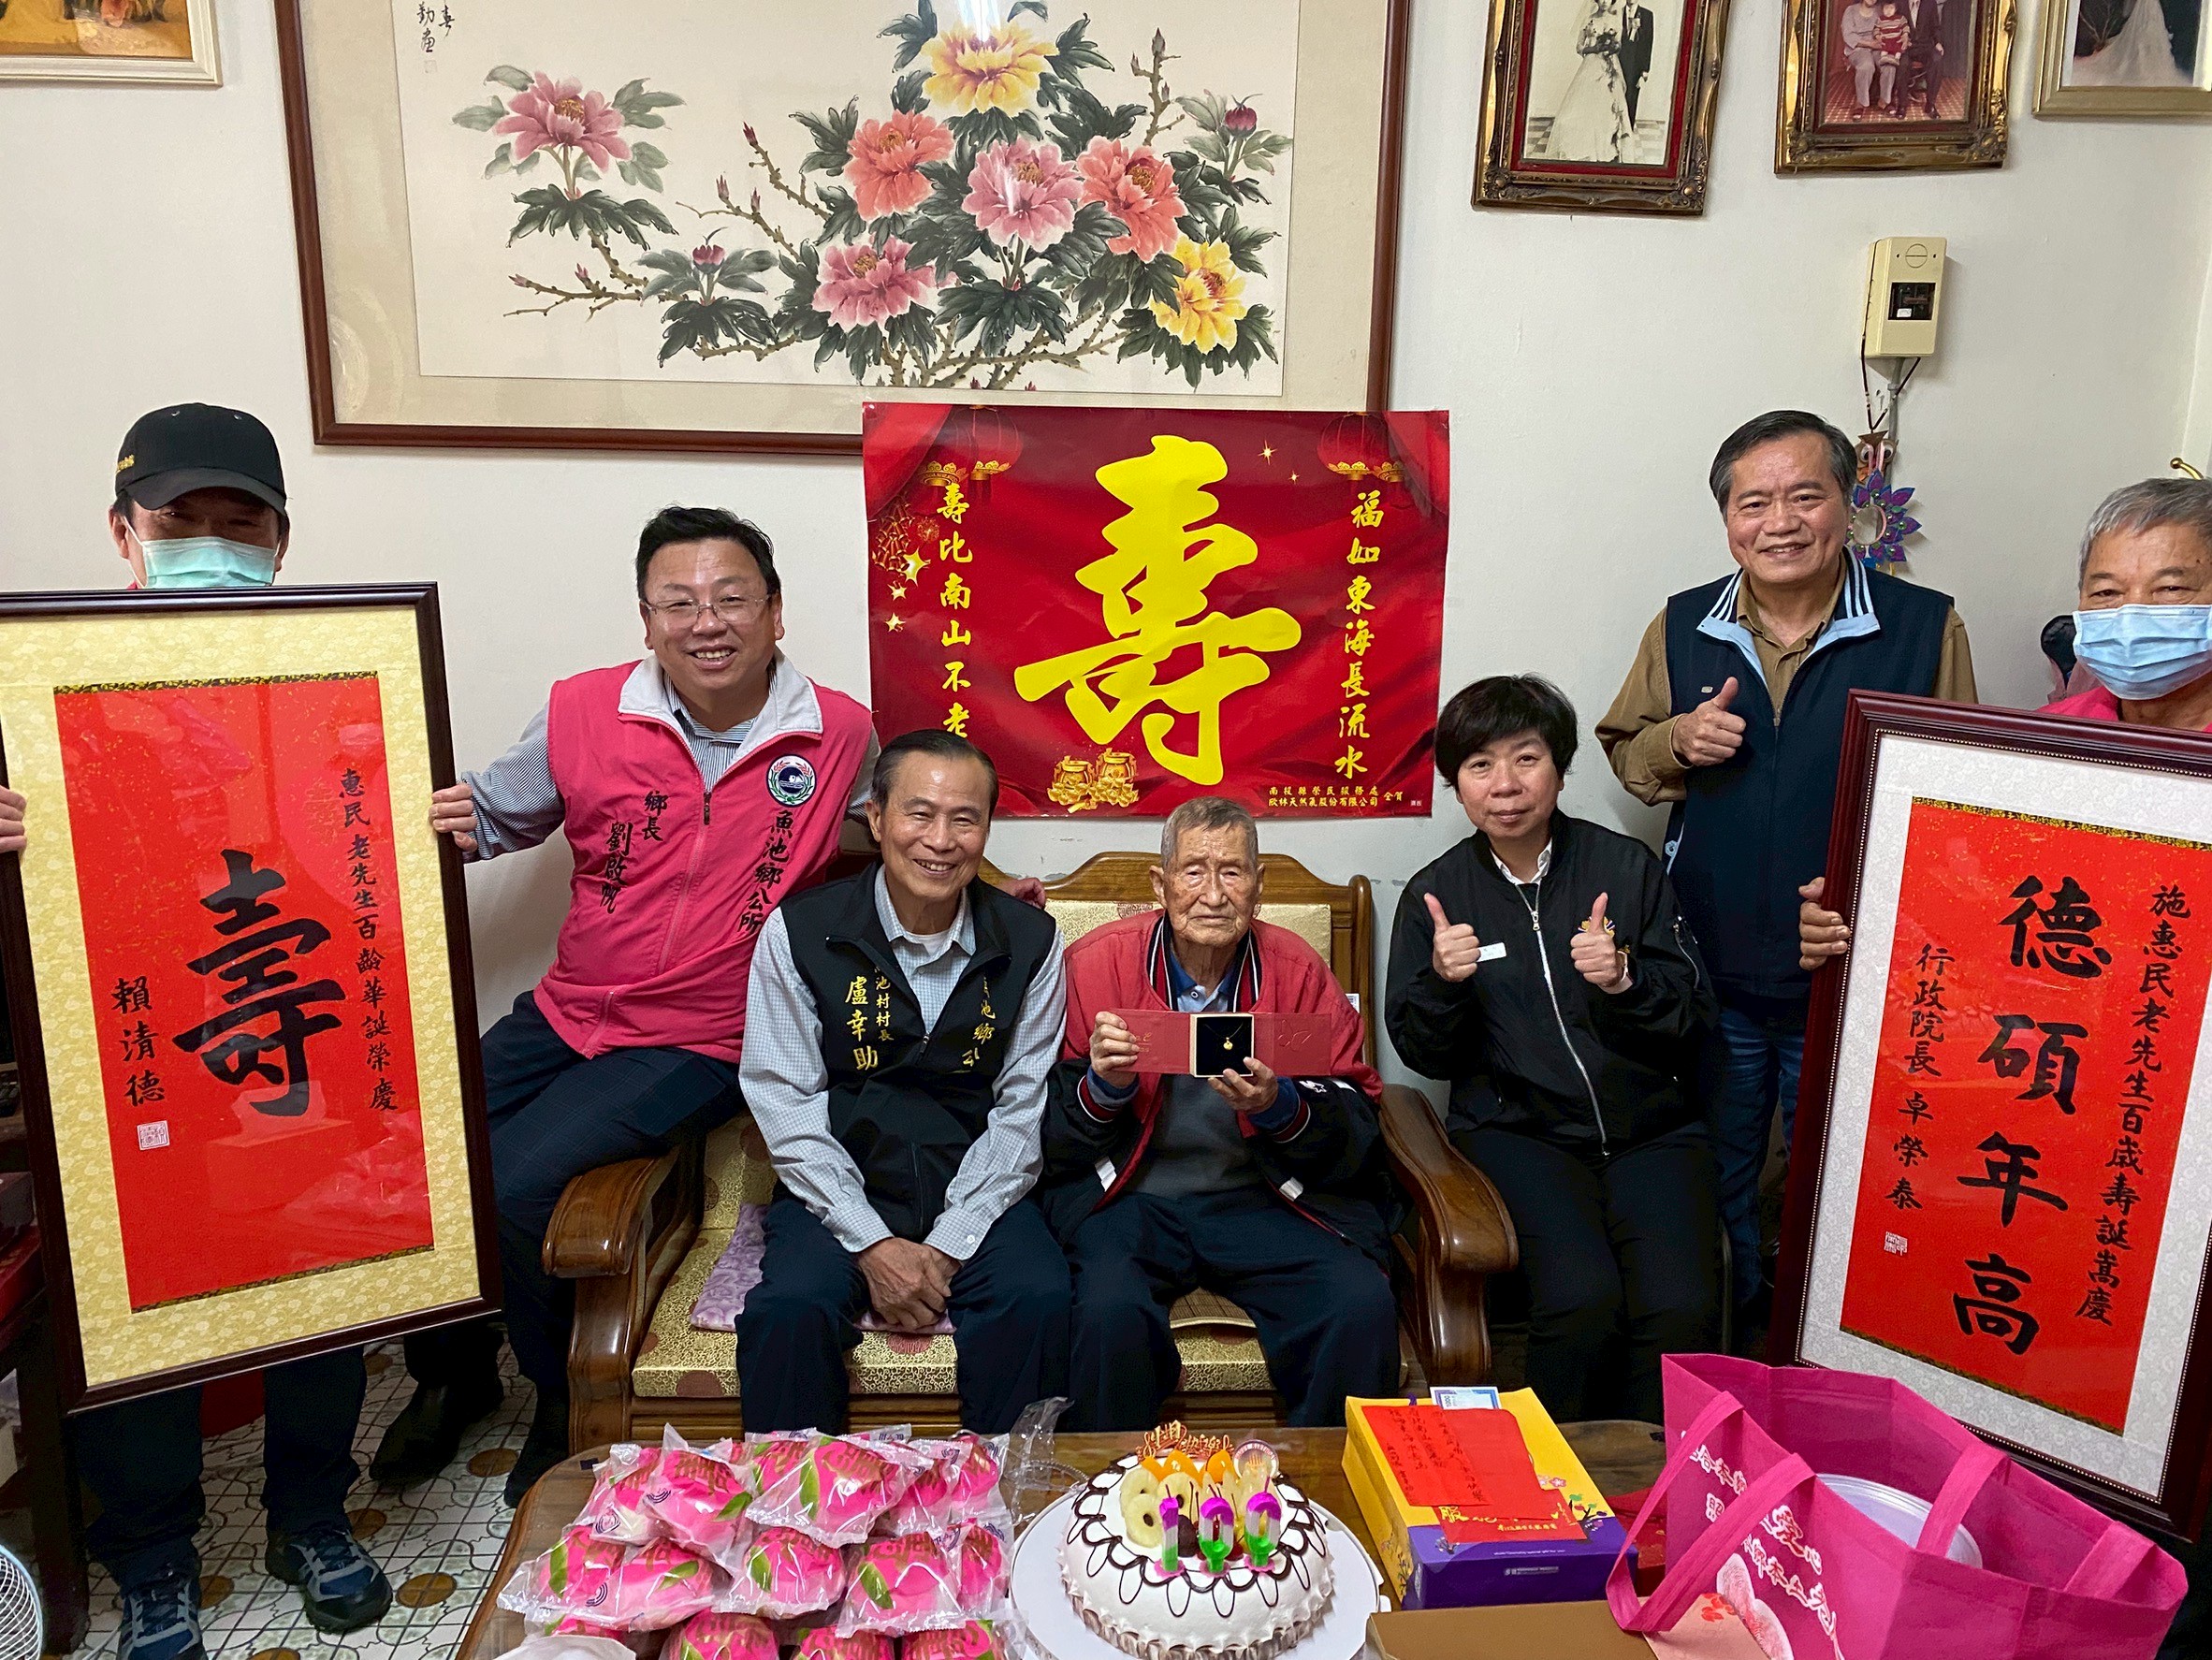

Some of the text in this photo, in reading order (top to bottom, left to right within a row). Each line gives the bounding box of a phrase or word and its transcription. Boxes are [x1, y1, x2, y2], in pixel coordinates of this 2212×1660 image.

[937, 484, 973, 738] 壽比南山不老
[1014, 435, 1302, 785] 壽
[1335, 490, 1384, 780] 福如東海長流水
[339, 767, 398, 1111] 惠民老先生百齡華誕榮慶
[642, 790, 669, 841] 鄉長
[737, 809, 794, 935] 魚池鄉公所
[111, 975, 165, 1107] 賴清德
[172, 849, 346, 1116] 壽
[845, 976, 878, 1070] 盧幸助
[874, 967, 894, 1041] 池村村長
[1952, 874, 2112, 1355] 德碩年高
